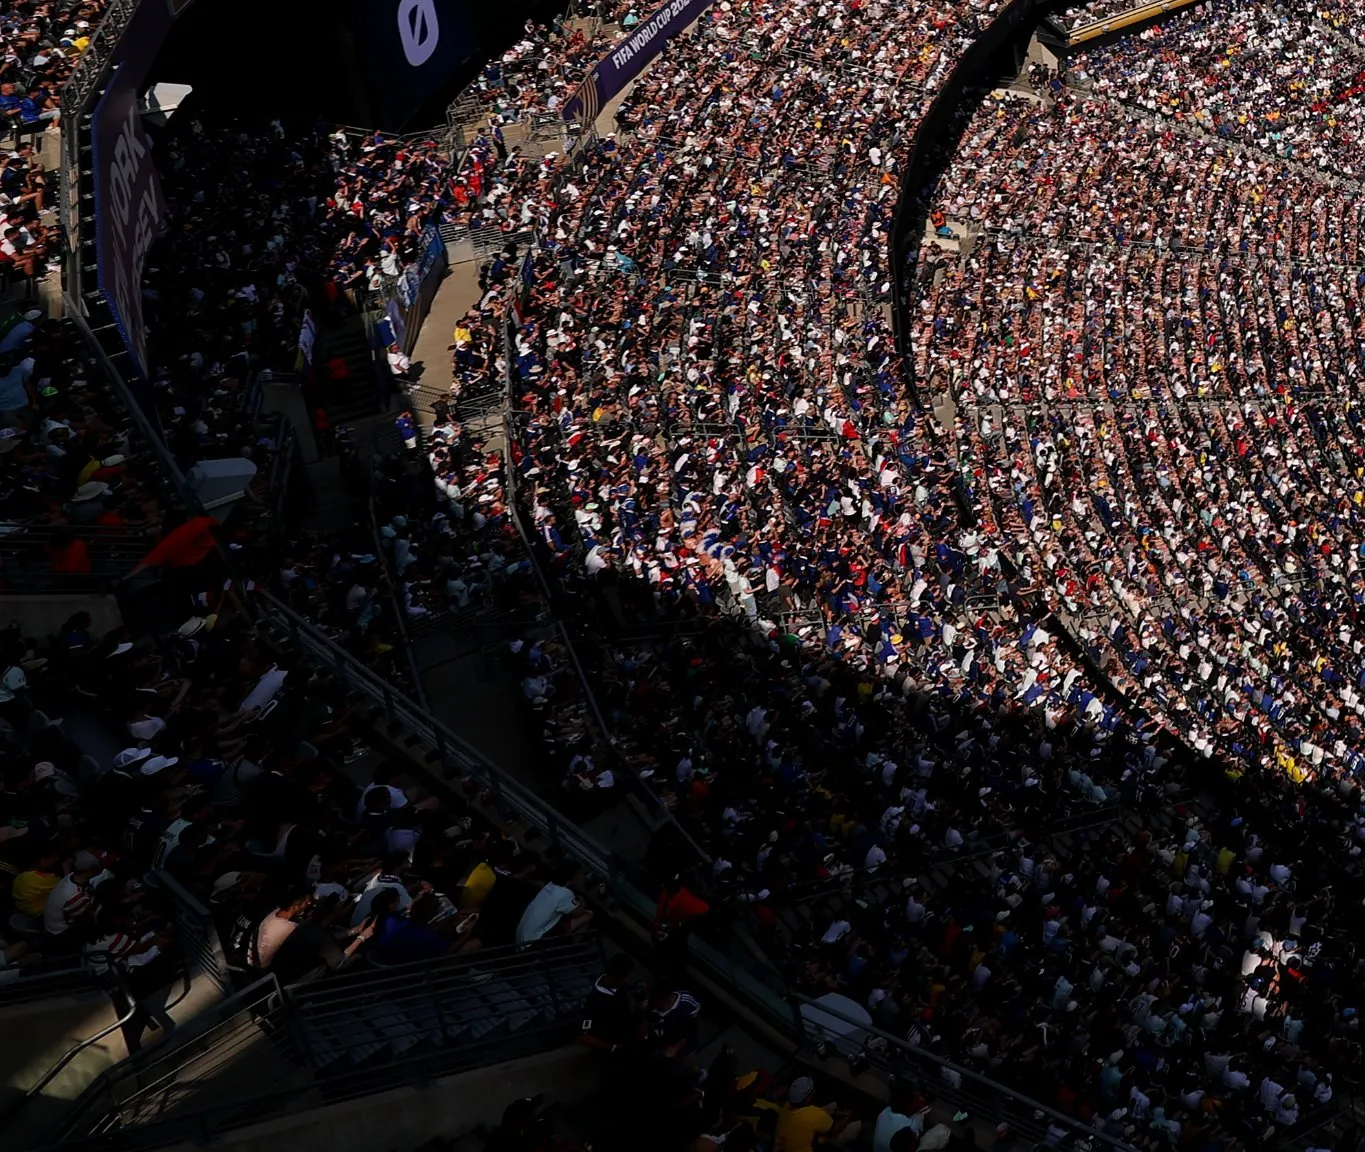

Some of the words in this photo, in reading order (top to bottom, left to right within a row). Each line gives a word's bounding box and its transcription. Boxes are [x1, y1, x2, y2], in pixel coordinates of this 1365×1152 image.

[612, 46, 635, 70] FIFA
[629, 22, 659, 53] WORLD
[656, 8, 673, 30] CUP
